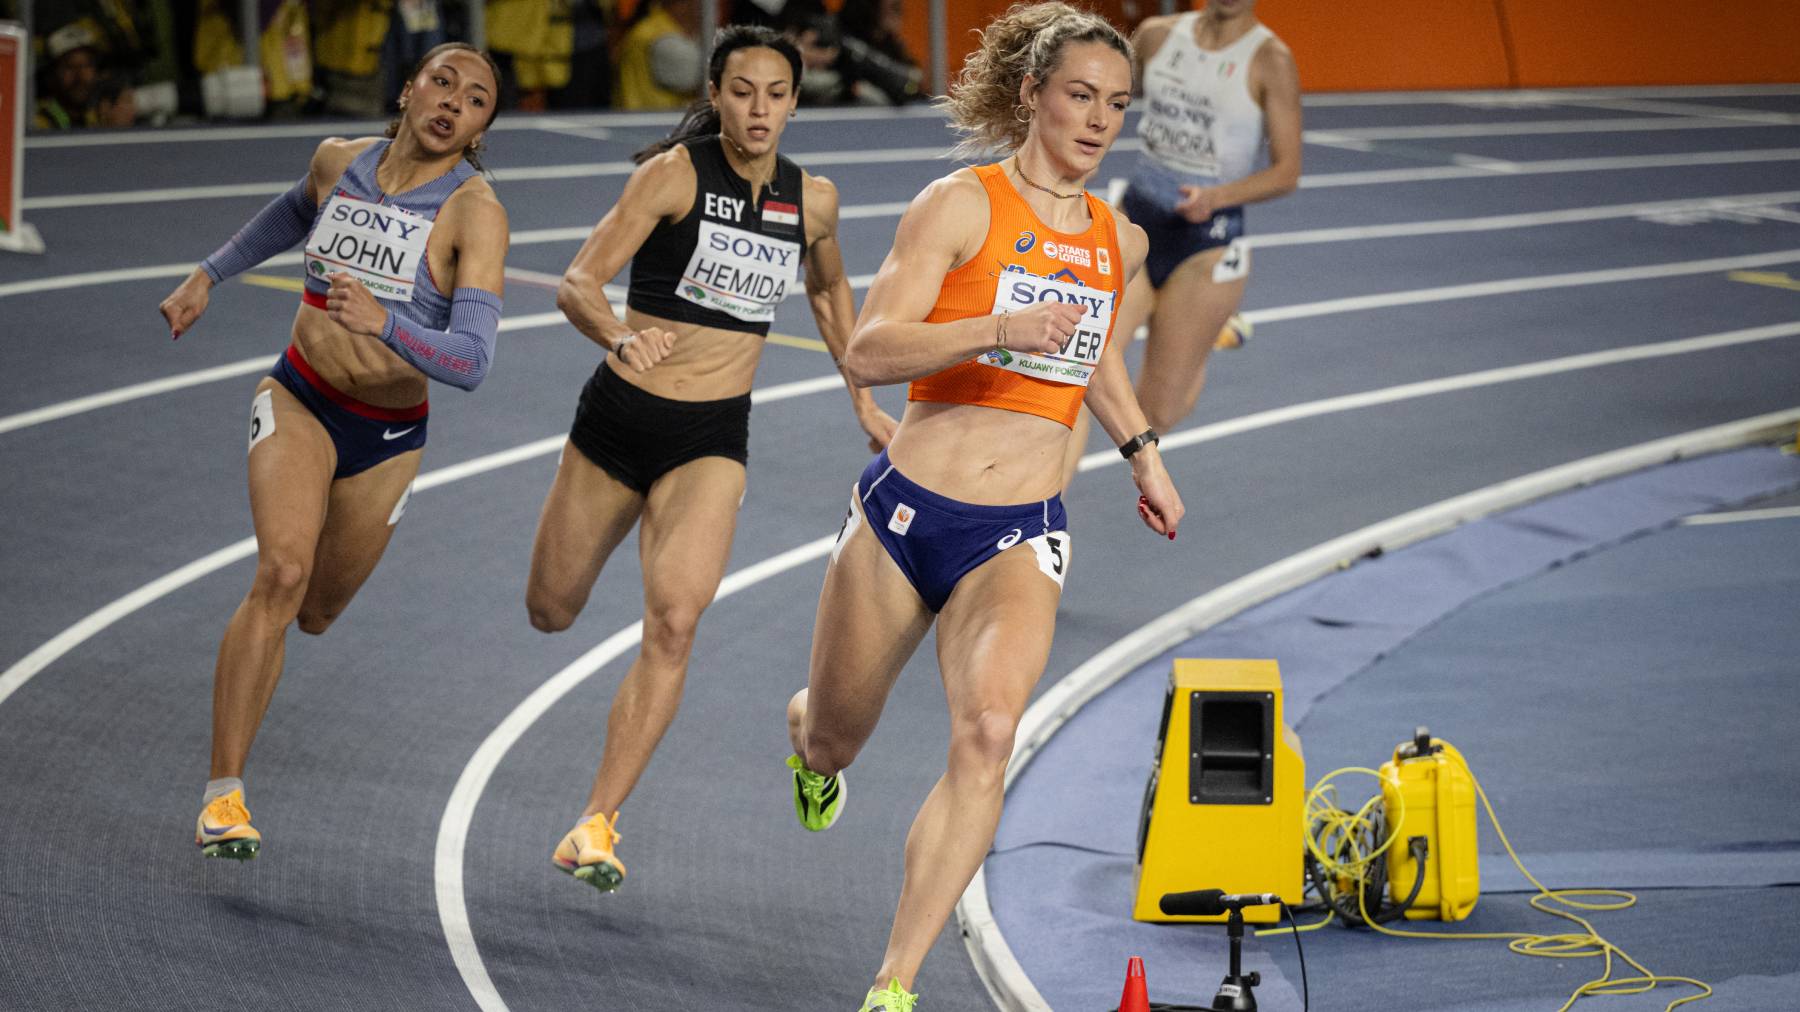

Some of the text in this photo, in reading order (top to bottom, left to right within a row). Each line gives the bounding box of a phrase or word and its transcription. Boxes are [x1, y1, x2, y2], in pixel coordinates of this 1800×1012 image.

[1150, 100, 1215, 131] SONY
[331, 204, 420, 240] SONY
[705, 192, 746, 222] EGY
[318, 233, 405, 274] JOHN
[709, 232, 793, 267] SONY
[1058, 243, 1090, 259] STAATS
[693, 258, 786, 303] HEMIDA
[1018, 359, 1053, 374] KUJAWY
[251, 405, 261, 441] 6
[1046, 535, 1063, 576] 5
